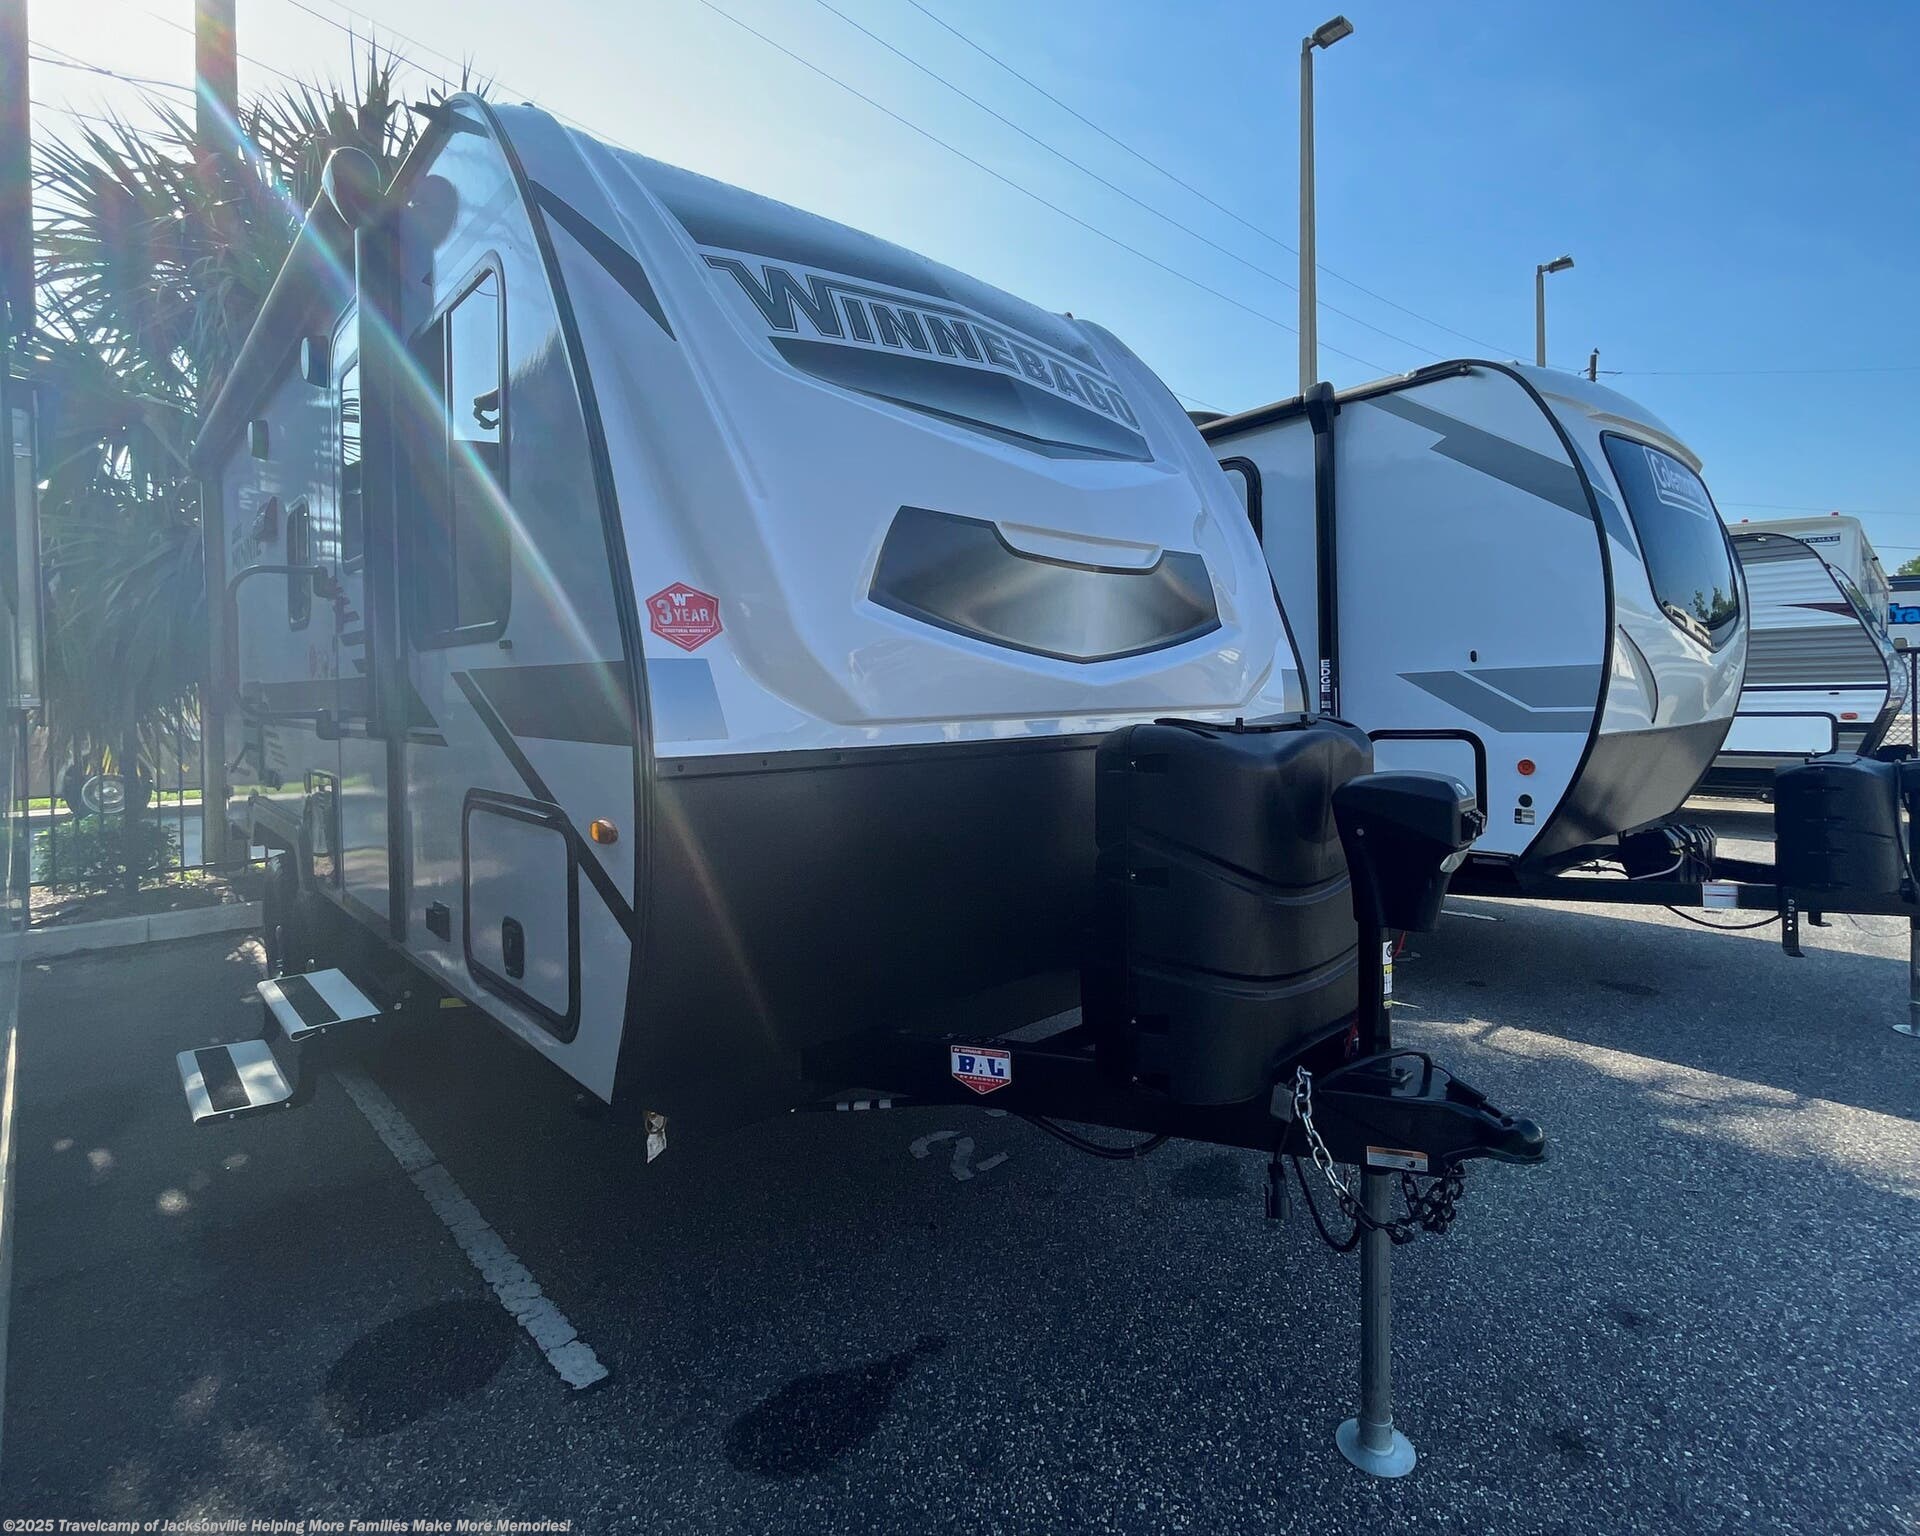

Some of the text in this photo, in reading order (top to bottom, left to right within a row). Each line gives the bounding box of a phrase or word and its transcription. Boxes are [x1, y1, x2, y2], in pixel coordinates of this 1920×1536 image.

[700, 253, 1140, 431] WINNEBAGO
[656, 599, 709, 625] 3 YEAR
[1321, 659, 1331, 693] EDGE
[957, 1054, 1005, 1077] BAL
